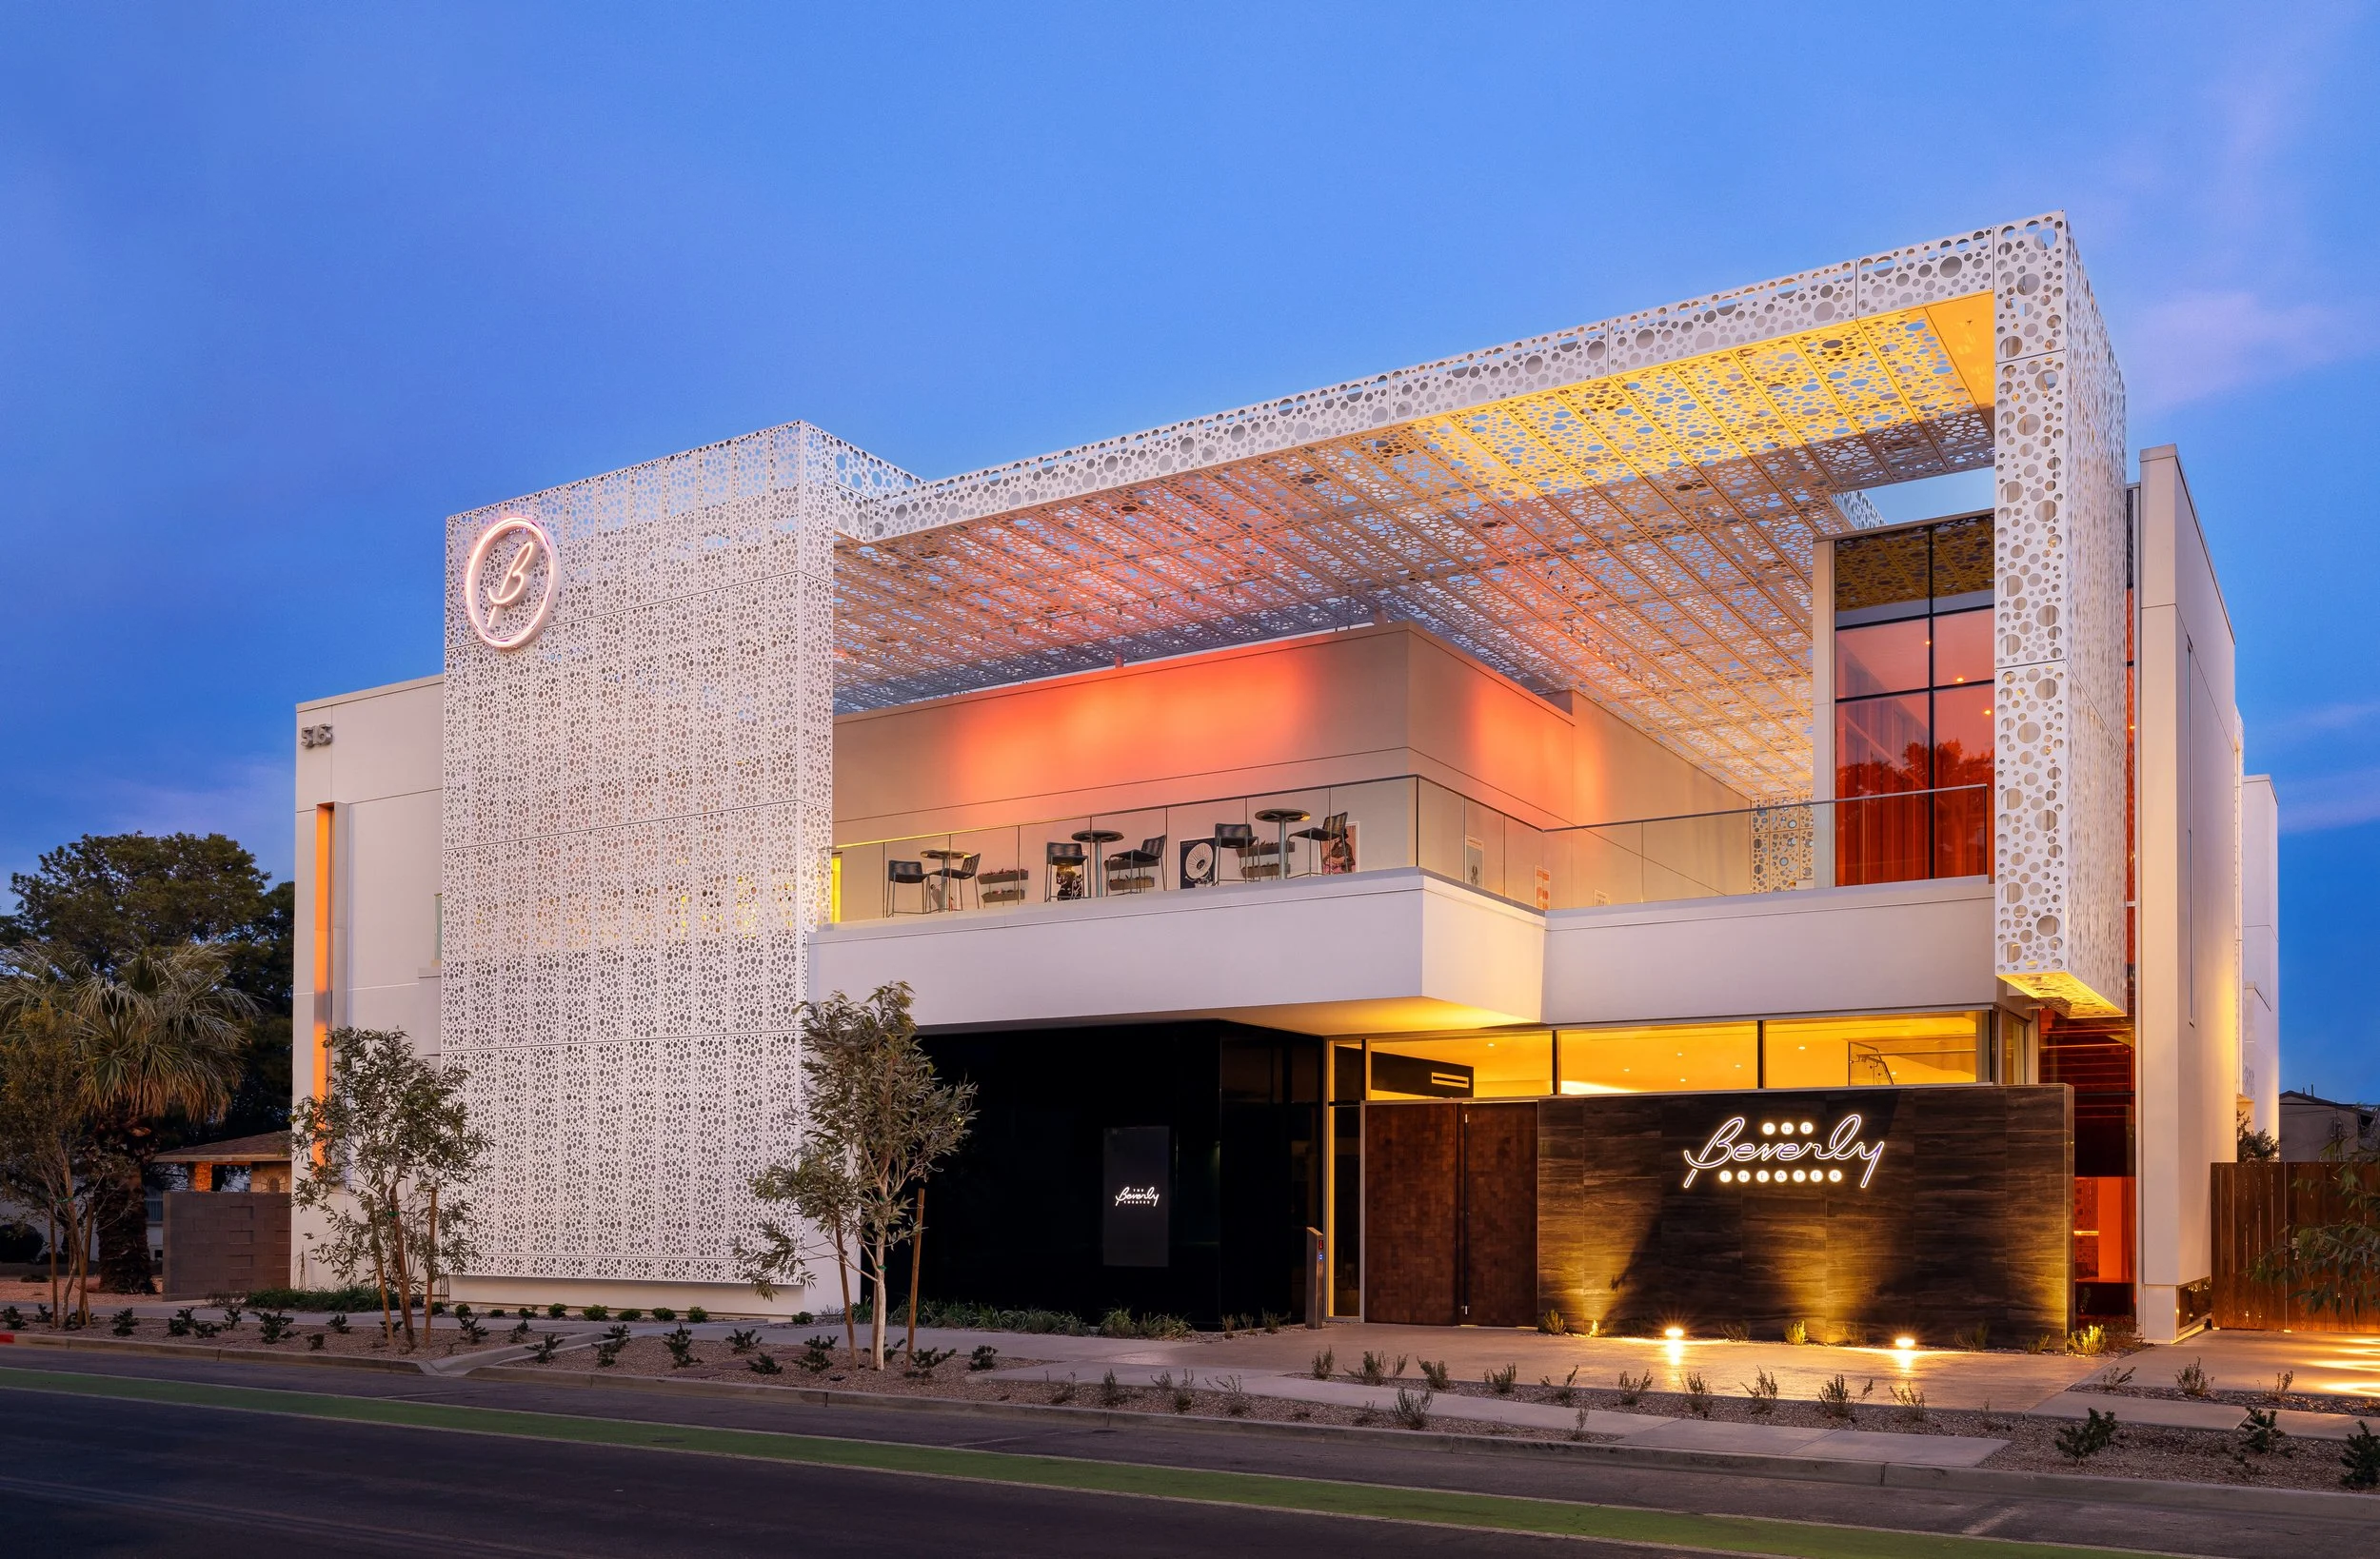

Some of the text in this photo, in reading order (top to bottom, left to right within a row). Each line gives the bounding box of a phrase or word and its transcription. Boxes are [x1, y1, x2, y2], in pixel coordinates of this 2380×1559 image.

[486, 542, 534, 628] B
[1765, 1123, 1810, 1133] THE
[1683, 1114, 1885, 1188] Beverly
[1721, 1172, 1839, 1181] THEATER
[1115, 1186, 1160, 1207] Beverly
